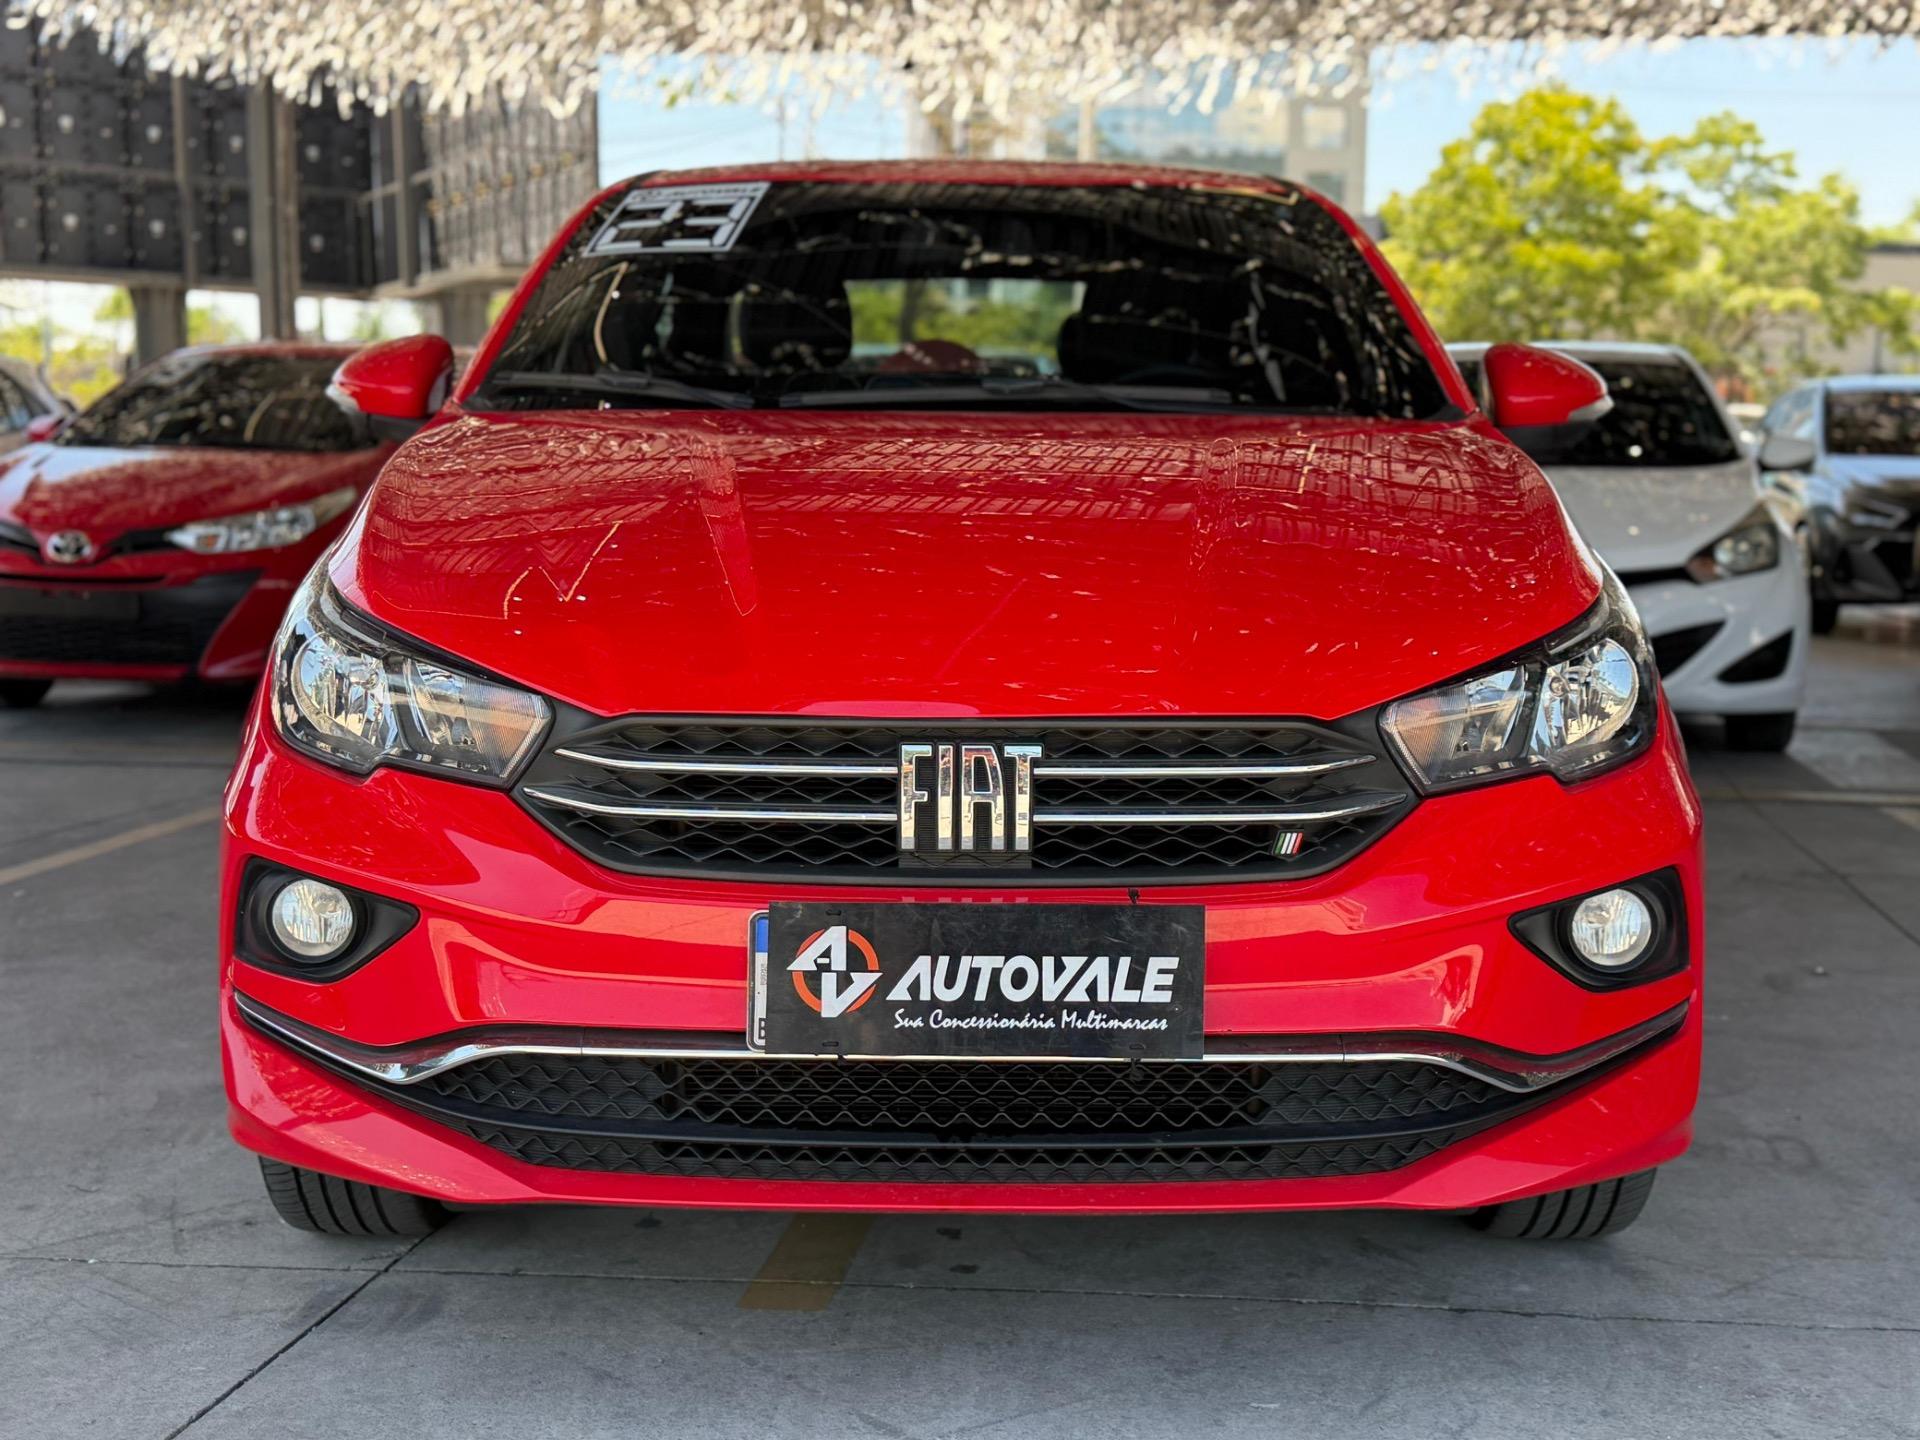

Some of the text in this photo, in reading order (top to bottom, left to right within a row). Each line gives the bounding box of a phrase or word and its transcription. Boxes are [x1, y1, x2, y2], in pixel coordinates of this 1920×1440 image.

[595, 197, 751, 252] 23
[901, 744, 1043, 850] FIAT
[886, 955, 1180, 1002] AUTOVALE
[894, 1008, 1168, 1030] Sua Concessionária Multimarcas
